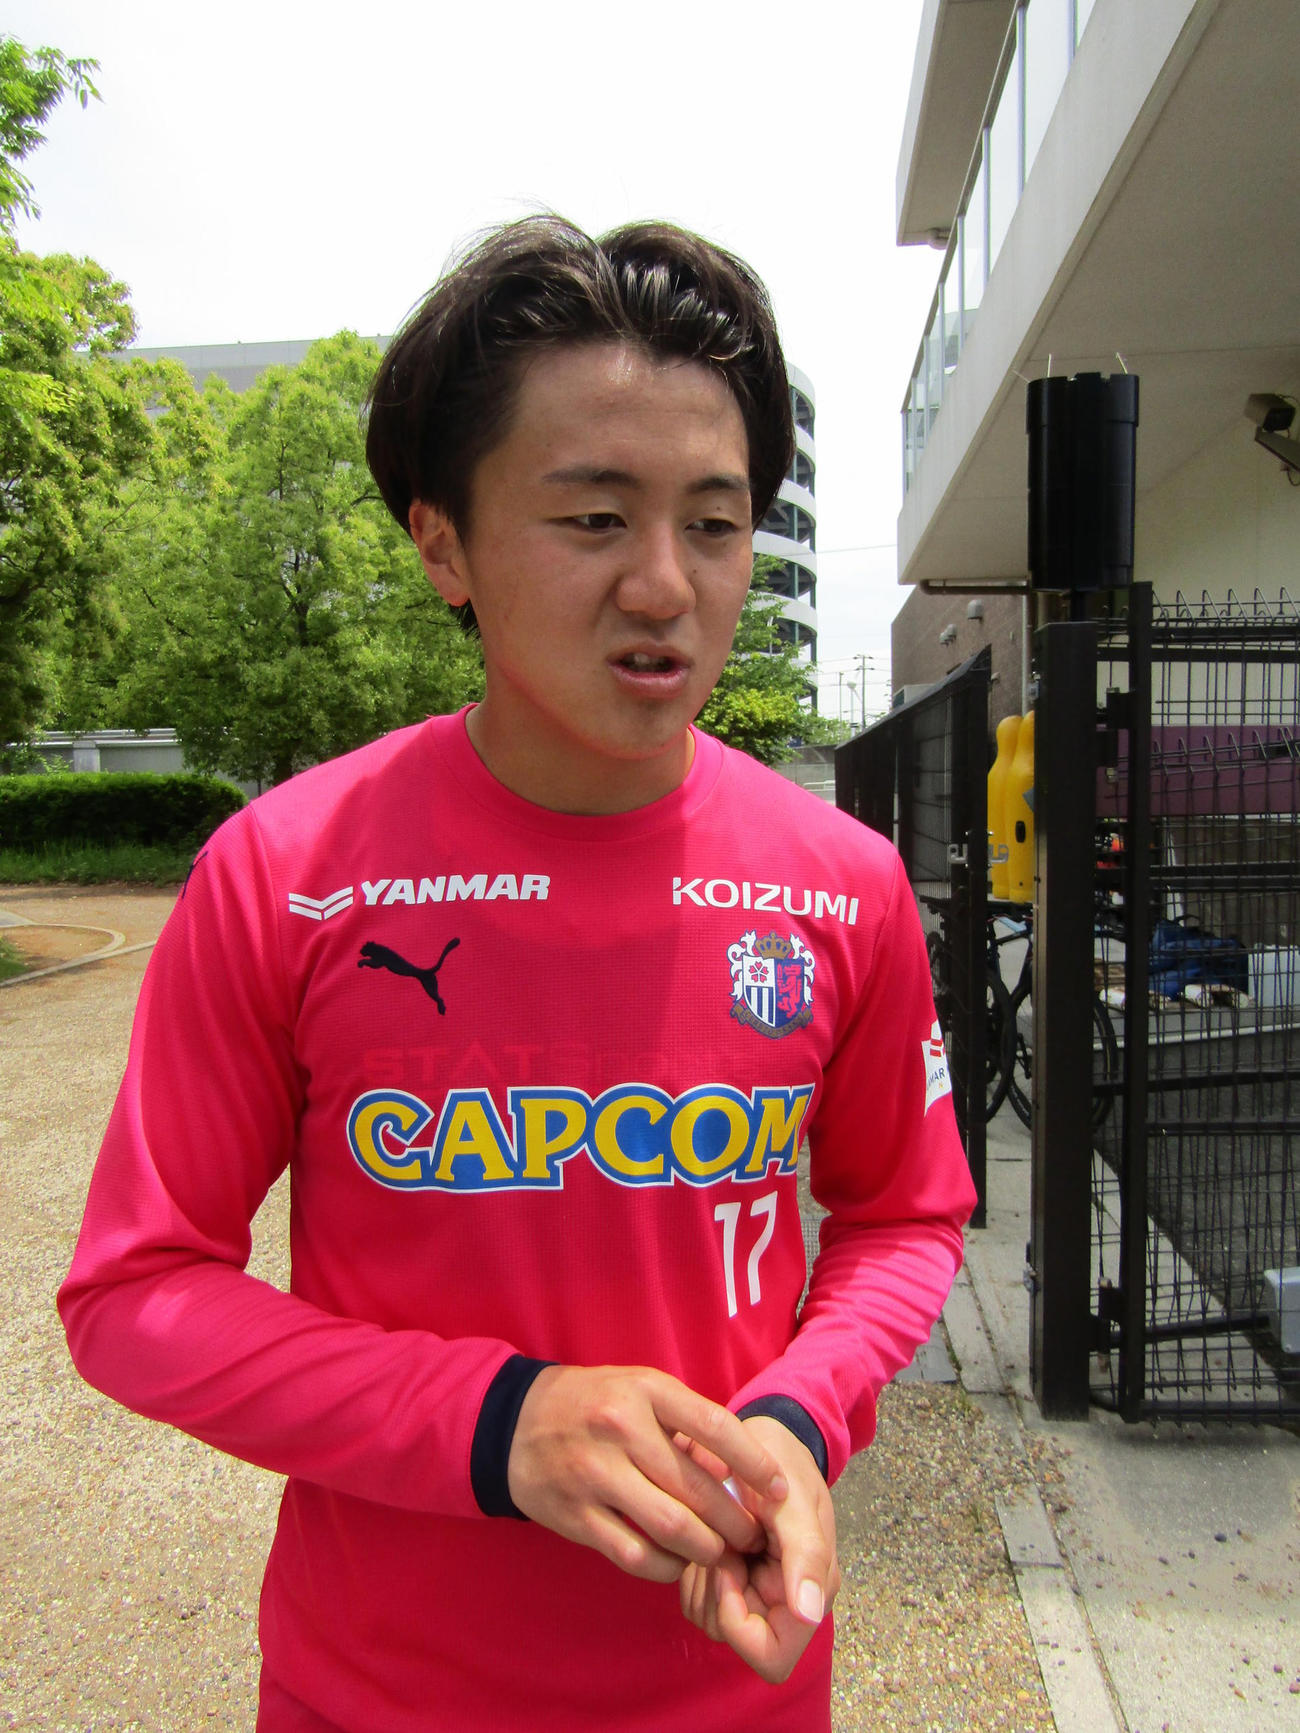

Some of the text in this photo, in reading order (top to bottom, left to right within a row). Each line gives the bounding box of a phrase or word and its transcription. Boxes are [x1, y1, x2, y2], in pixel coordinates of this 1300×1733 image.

[361, 874, 550, 905] YANMAR
[672, 877, 859, 925] KOIZUMI
[346, 1083, 815, 1191] CAPCOM
[714, 1191, 778, 1317] 17
